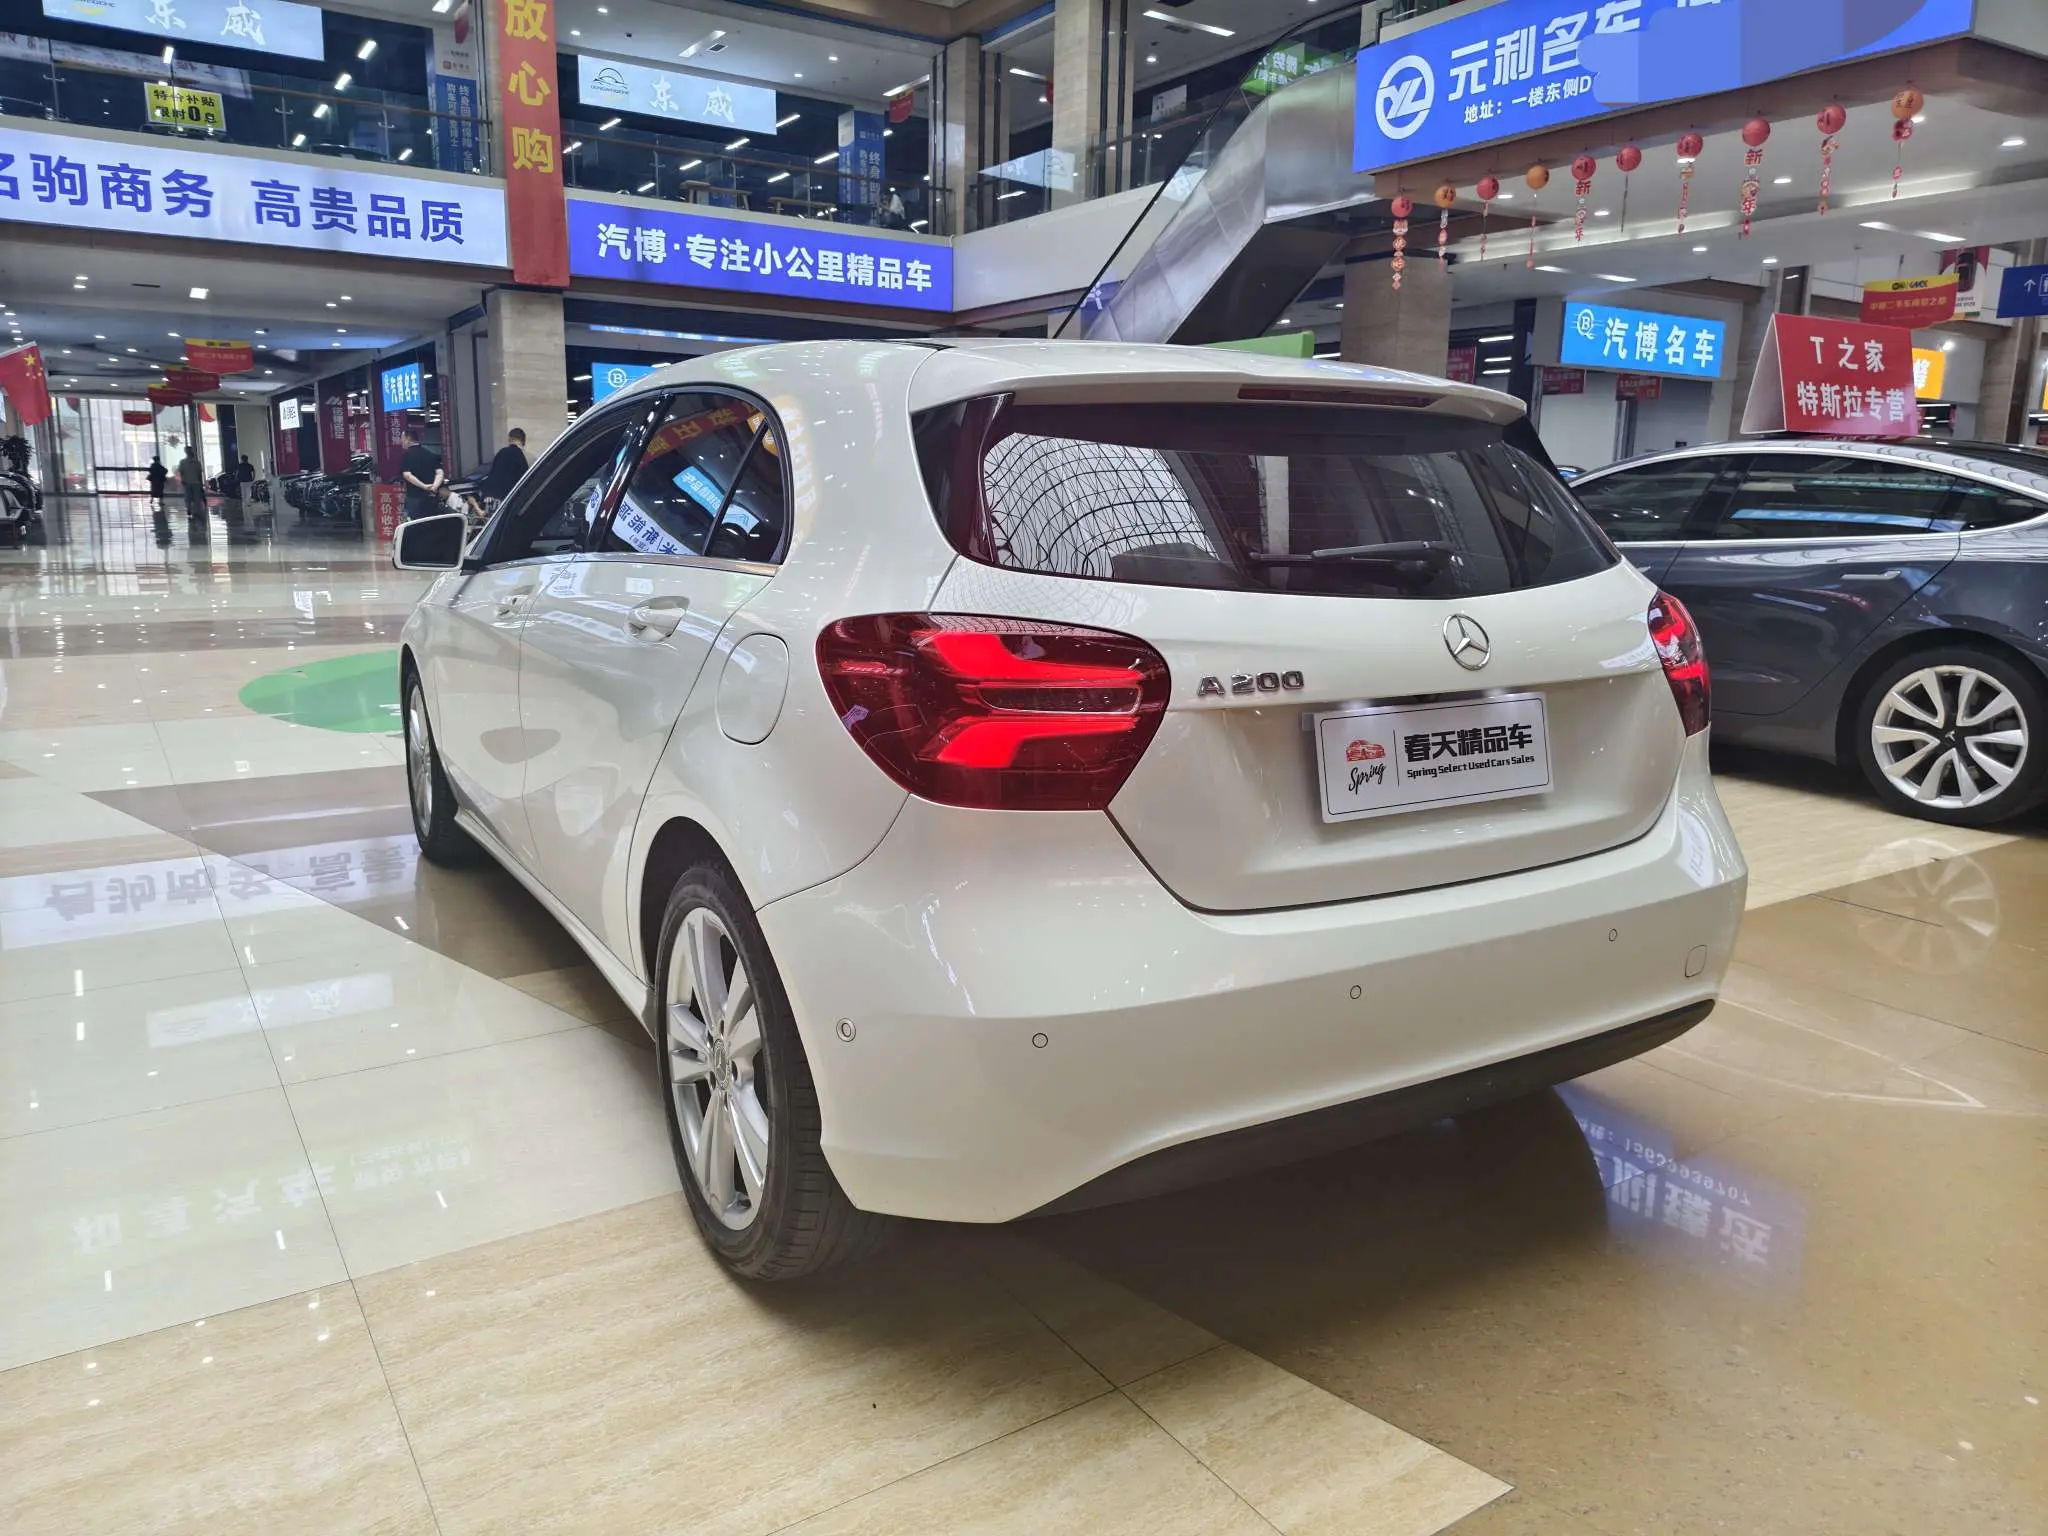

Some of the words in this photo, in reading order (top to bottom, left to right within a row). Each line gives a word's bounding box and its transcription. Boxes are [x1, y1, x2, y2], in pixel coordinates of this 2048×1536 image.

[1464, 72, 1597, 124] 地址：一楼东侧D
[251, 179, 465, 246] 高贵品质
[597, 223, 932, 292] 汽博·专注小公里精品车
[1603, 318, 1716, 368] 汽博名车
[1796, 380, 1906, 422] 特斯拉专营
[1198, 676, 1226, 697] A
[1230, 670, 1305, 696] 200
[1403, 723, 1533, 763] 春天精品车
[1348, 763, 1387, 795] Spring
[1406, 767, 1438, 779] Spring
[1438, 763, 1467, 775] Select
[1468, 759, 1490, 770] Used
[1491, 757, 1511, 767] Cars
[1511, 755, 1535, 765] Sales
